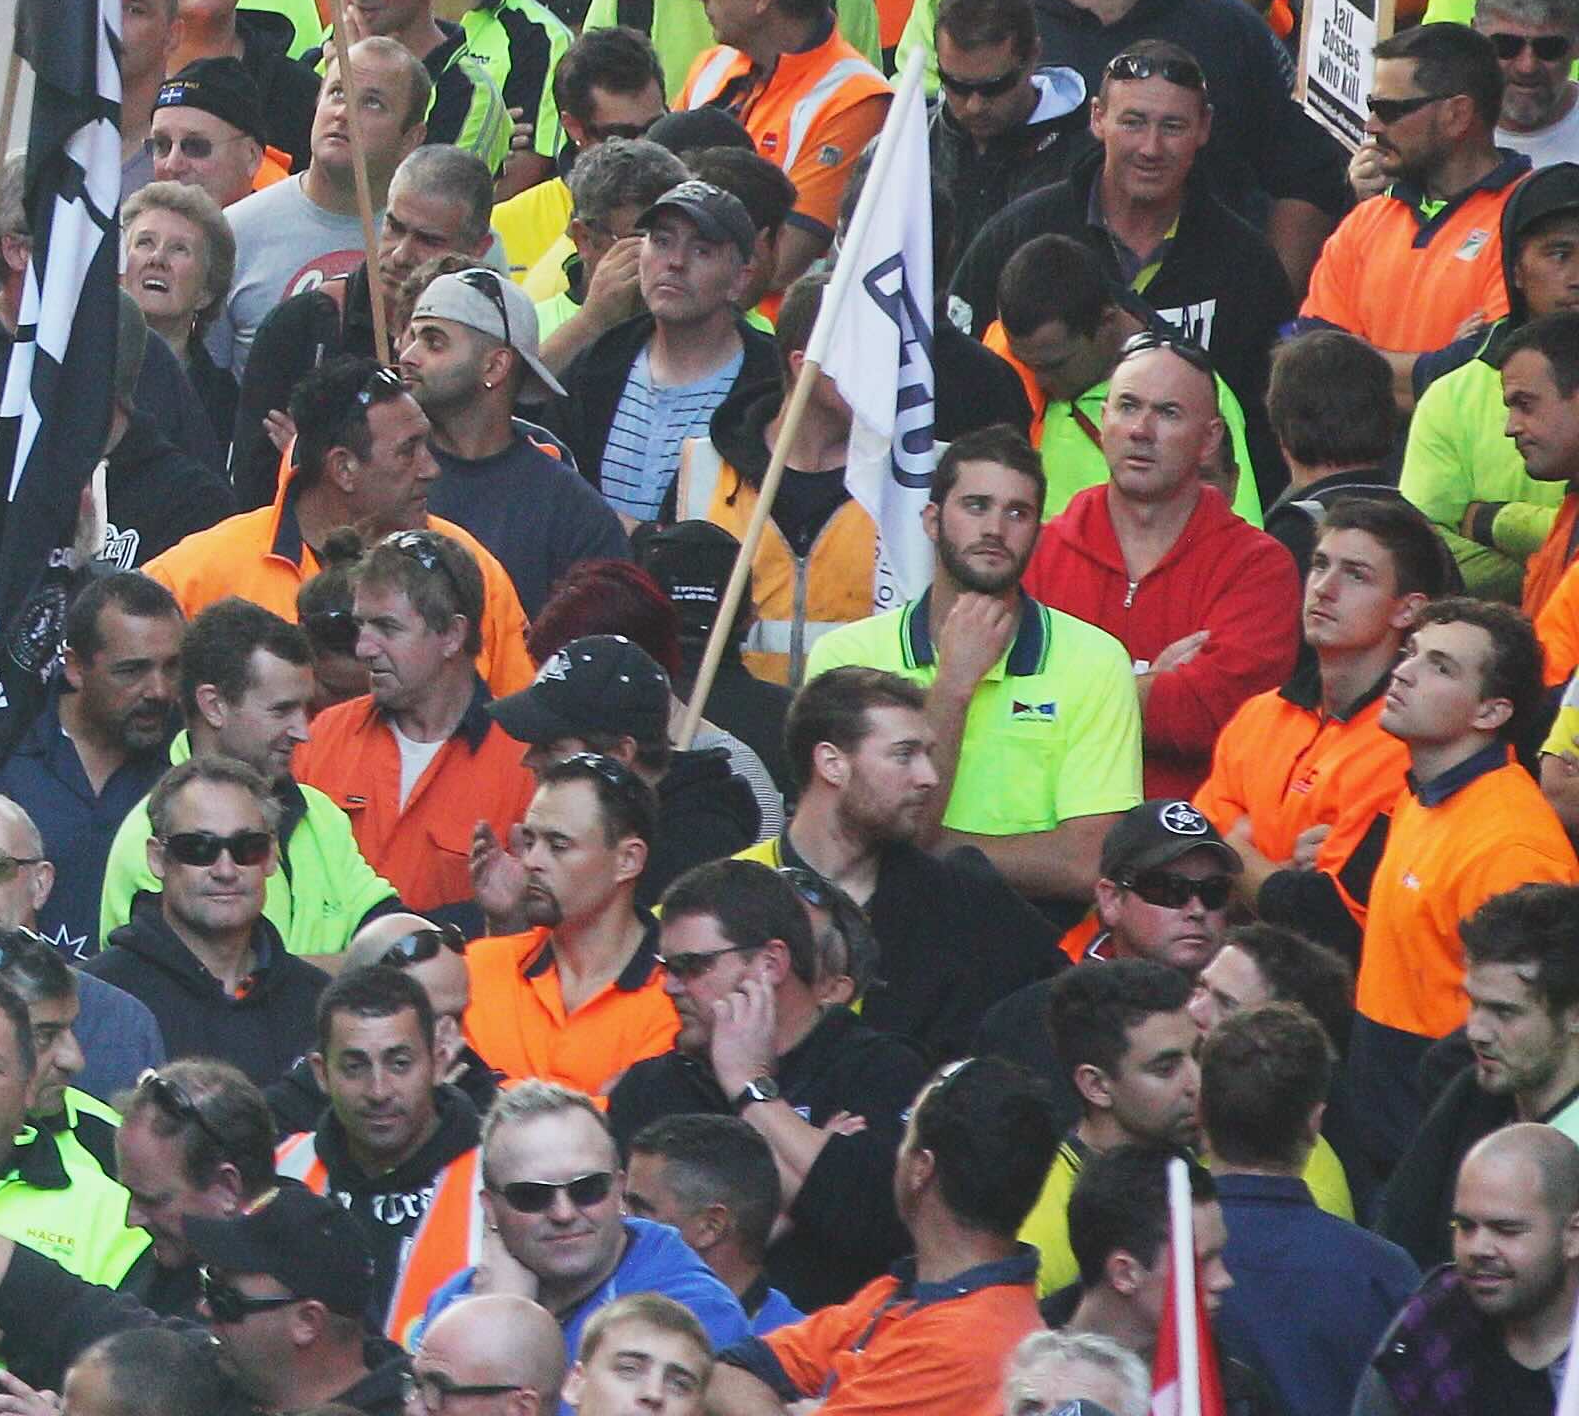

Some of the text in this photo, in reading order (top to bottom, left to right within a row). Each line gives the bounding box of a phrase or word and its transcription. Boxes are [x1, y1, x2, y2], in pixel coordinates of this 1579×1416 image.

[1322, 17, 1360, 72] Bosses
[1333, 0, 1354, 39] Jail
[1318, 50, 1360, 105] who kill
